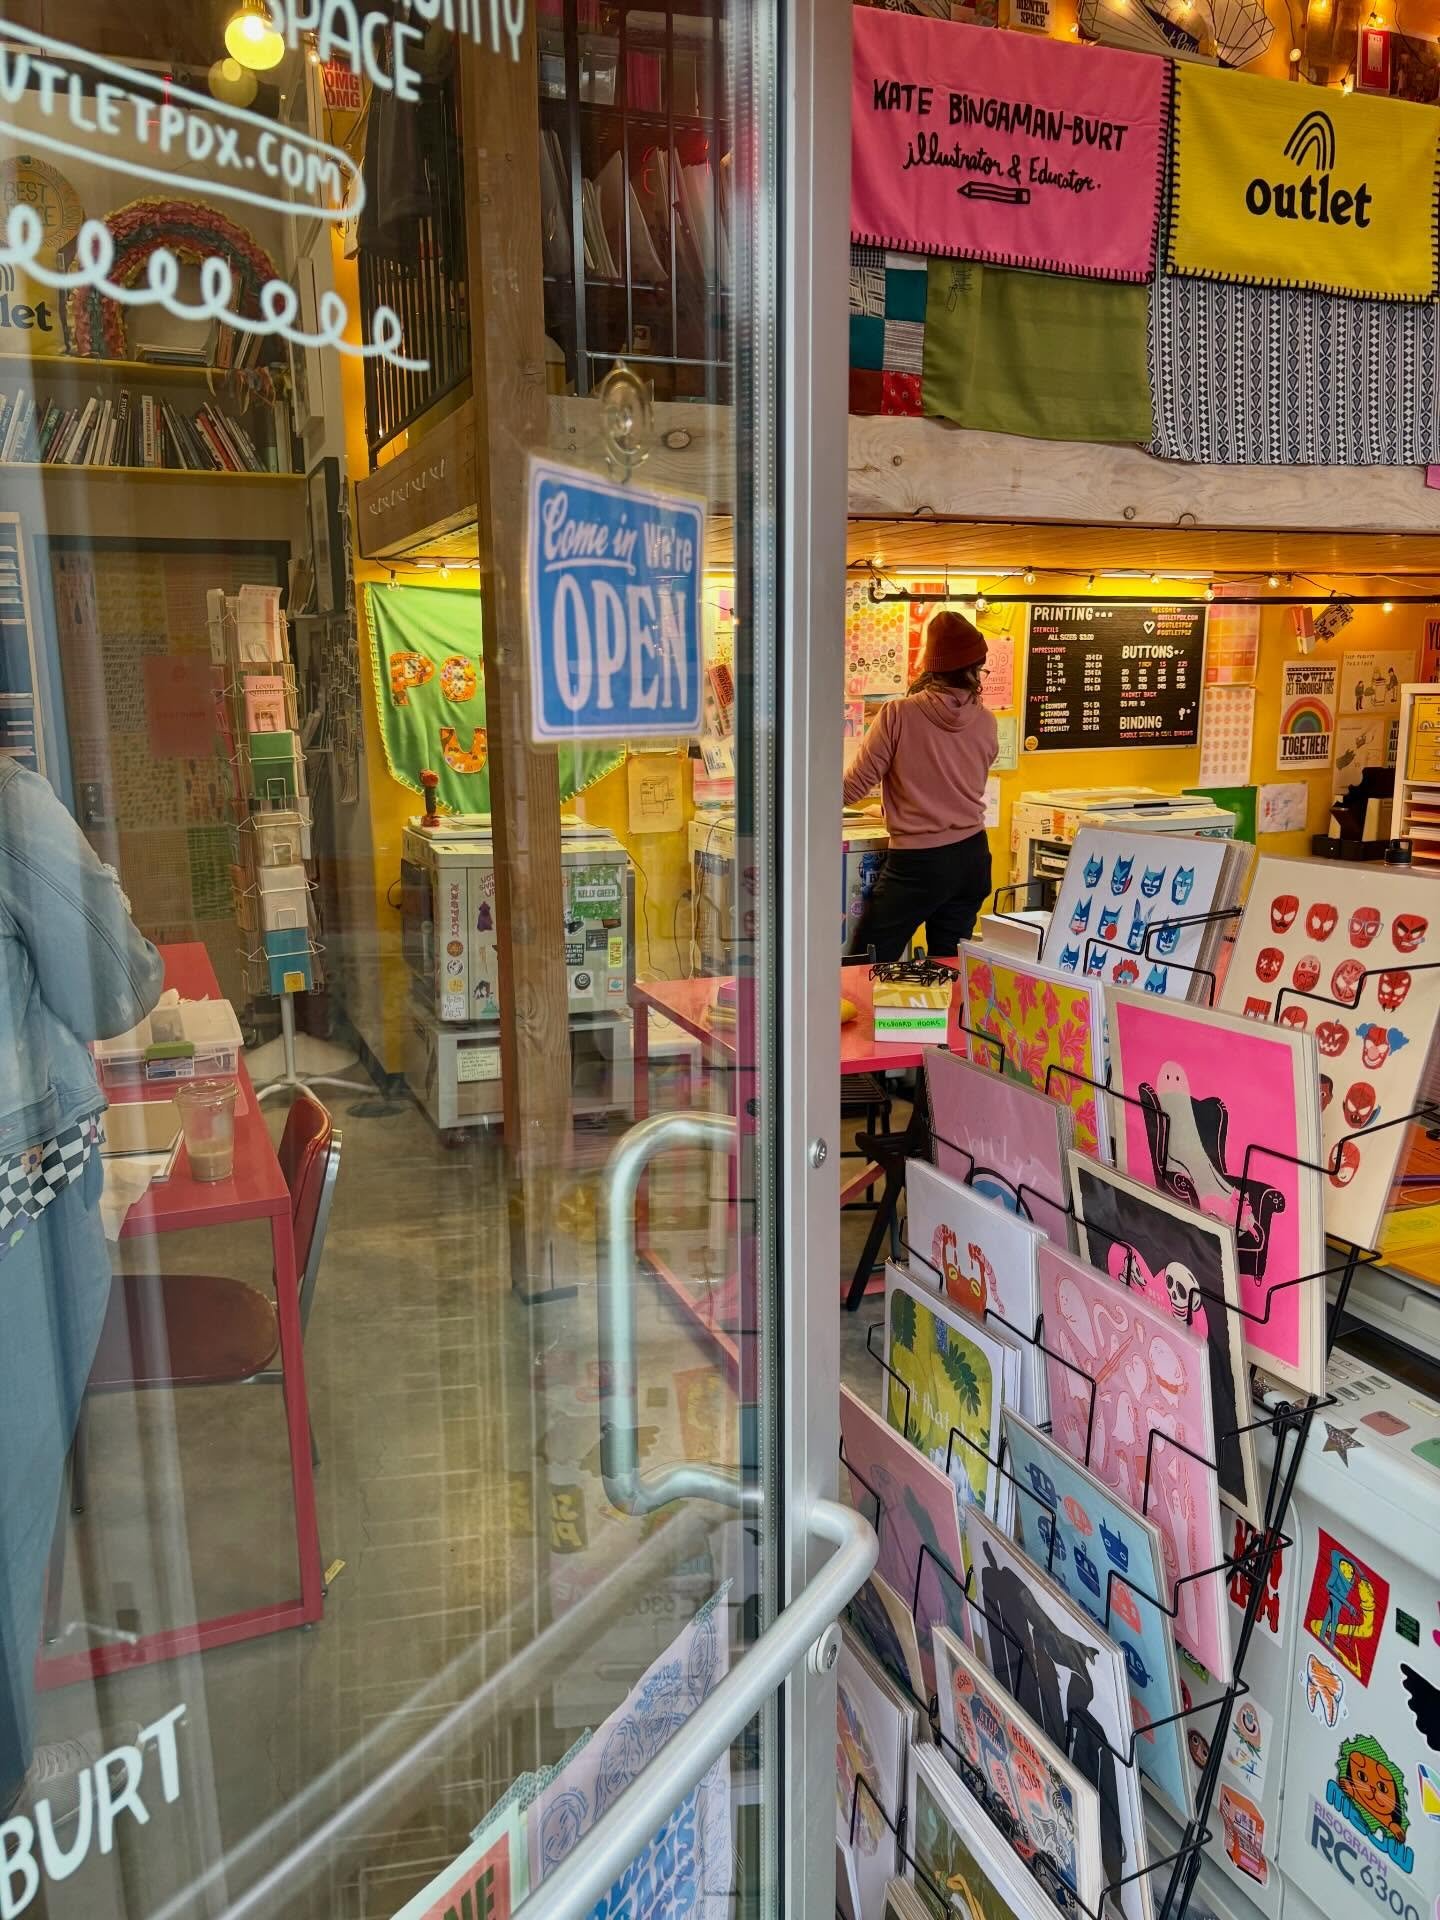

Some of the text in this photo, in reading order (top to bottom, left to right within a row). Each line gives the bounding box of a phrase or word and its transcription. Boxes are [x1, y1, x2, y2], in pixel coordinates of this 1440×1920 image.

[1020, 11, 1046, 27] SPACE
[873, 78, 934, 115] KATE
[1010, 155, 1022, 185] &
[1245, 174, 1373, 229] outlet
[544, 491, 693, 573] Come in We're
[1034, 607, 1094, 621] PRINTING
[553, 574, 689, 712] OPEN
[1122, 645, 1174, 659] BUTTONS
[1287, 672, 1335, 682] WE WILL
[1286, 682, 1334, 695] GET THROUGH THIS
[1120, 716, 1162, 729] BINDING
[1281, 734, 1330, 756] TOGETHER!
[597, 888, 616, 897] GREEN
[878, 1019, 941, 1028] PEGBOARD HOOKS
[0, 1703, 187, 1920] BURT
[1311, 1813, 1358, 1886] RC
[1314, 1801, 1388, 1878] RISOGRAPH
